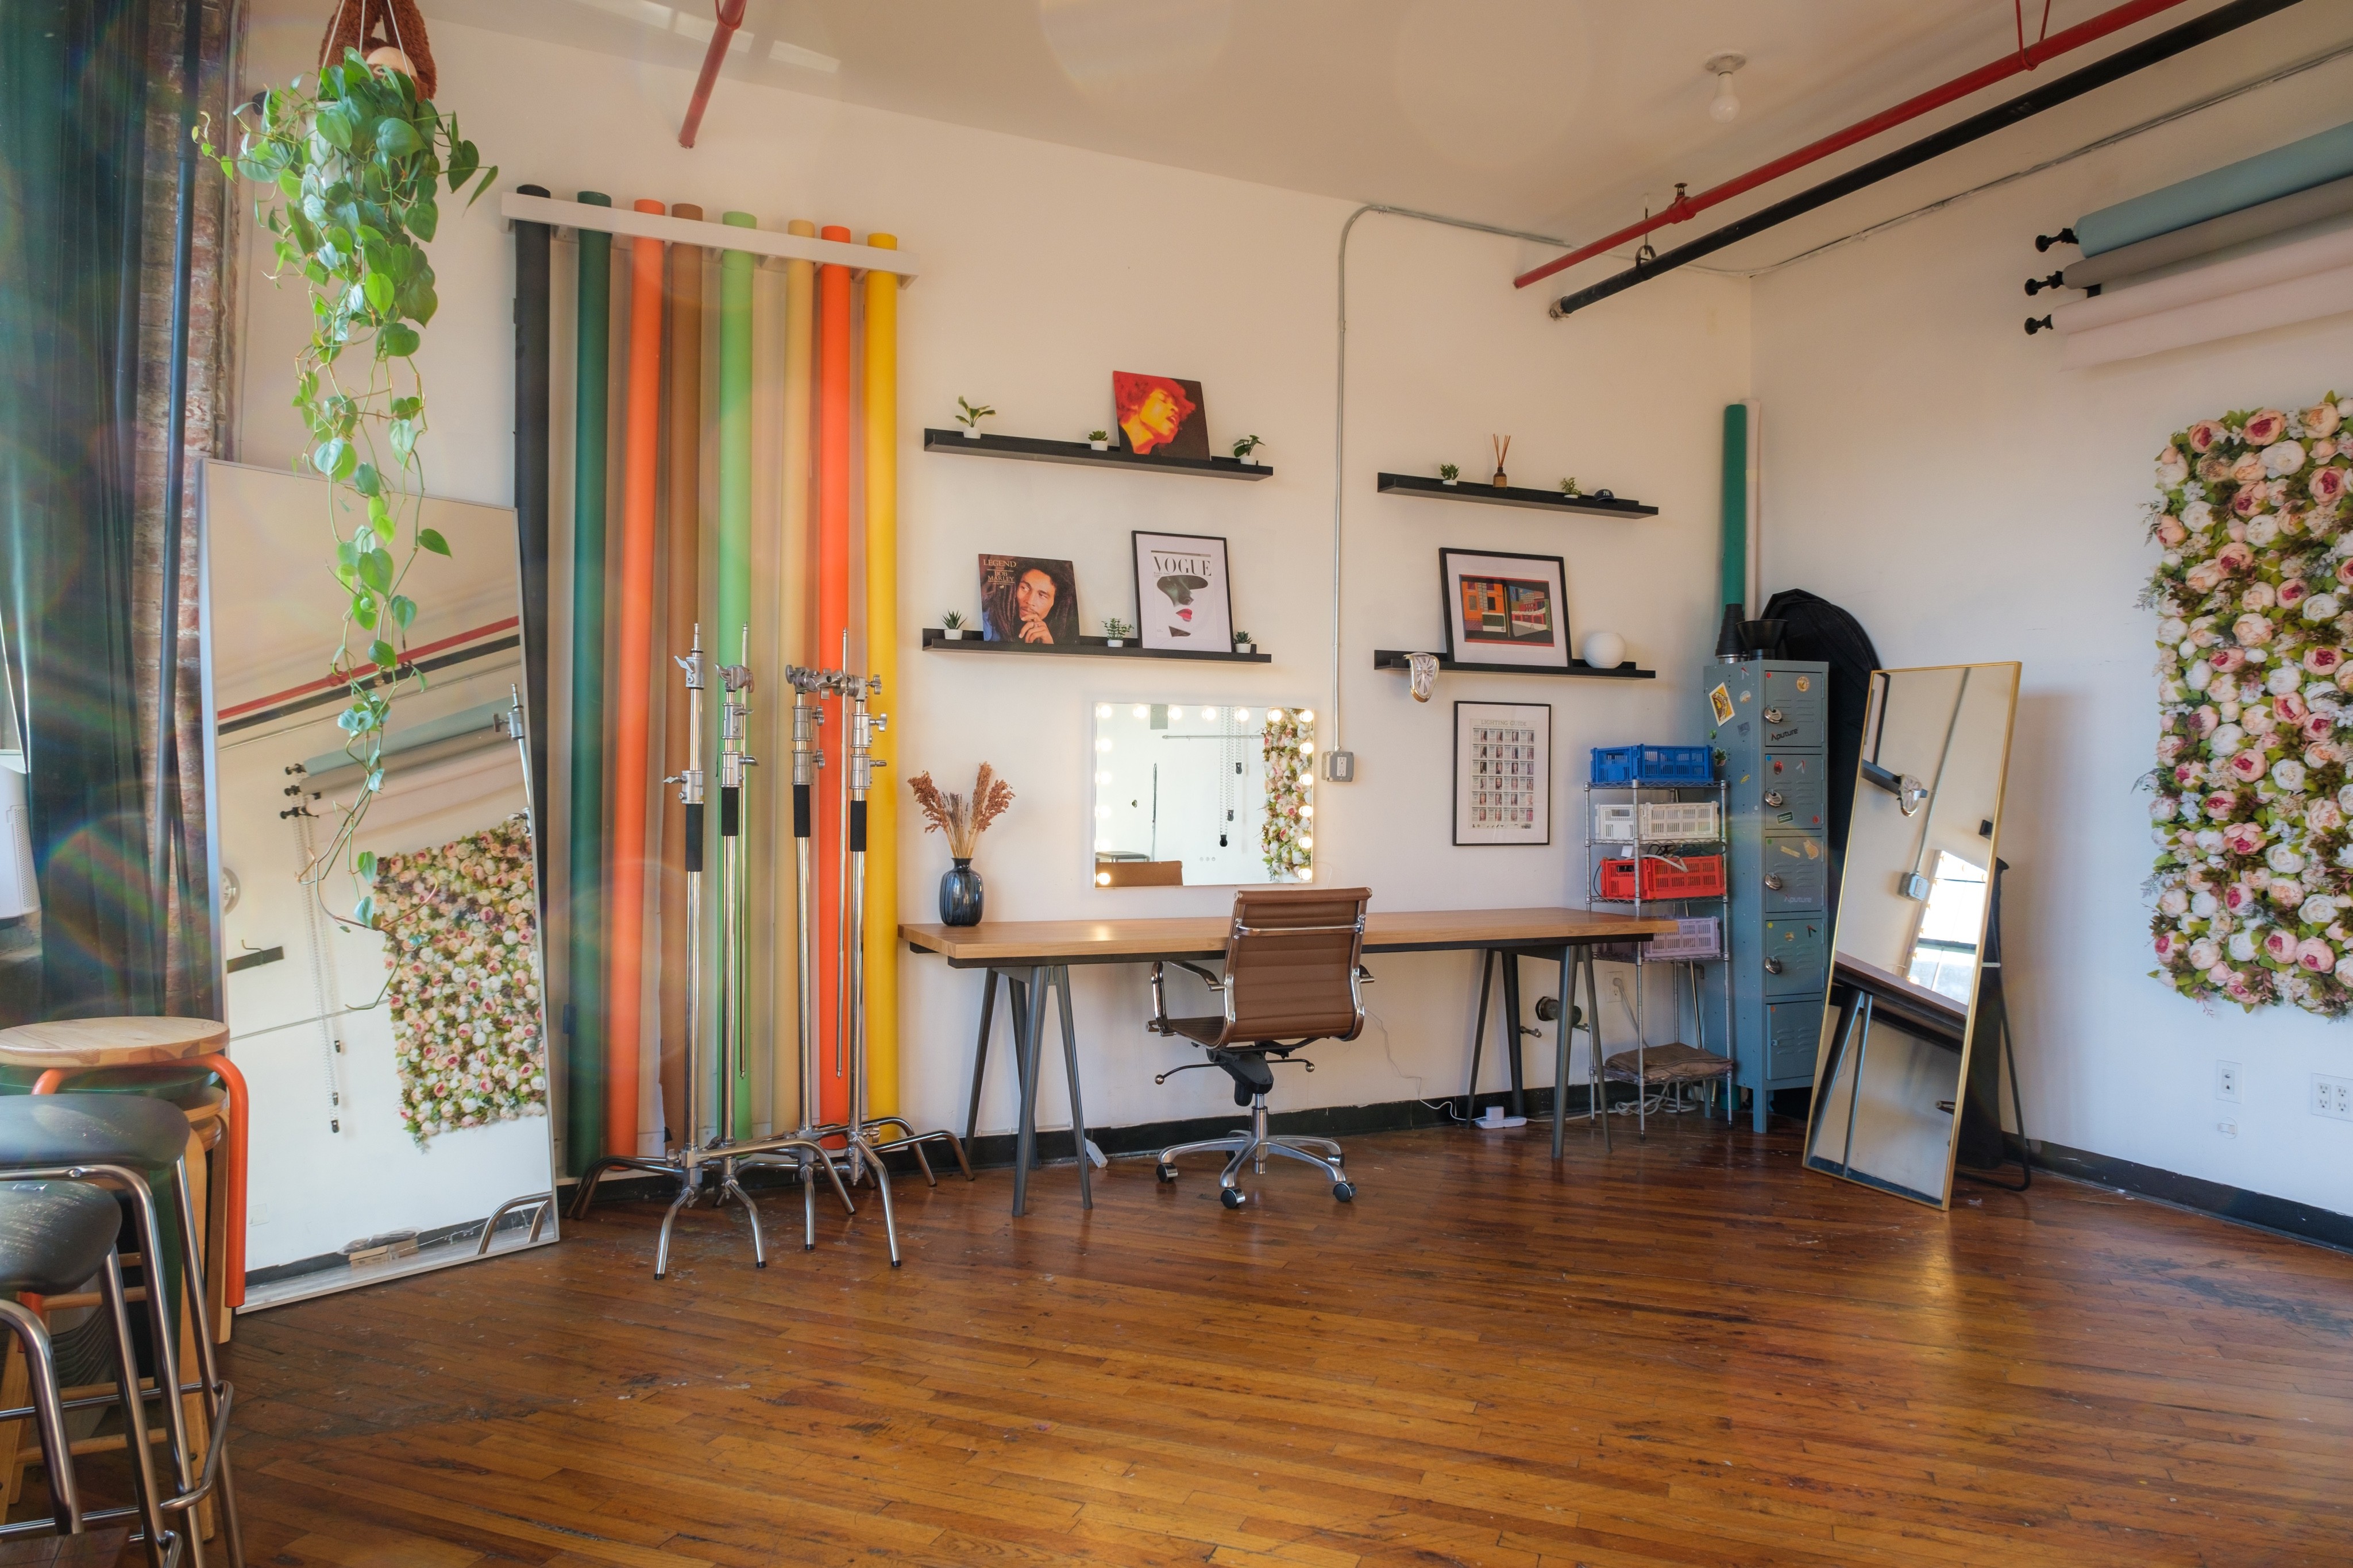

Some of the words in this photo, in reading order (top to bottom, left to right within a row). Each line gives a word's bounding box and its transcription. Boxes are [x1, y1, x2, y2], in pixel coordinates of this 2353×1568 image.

[983, 559, 1017, 567] LEGEND
[1154, 556, 1212, 576] VOGUE
[1771, 728, 1798, 741] Aputure
[1784, 894, 1812, 904] Aputure
